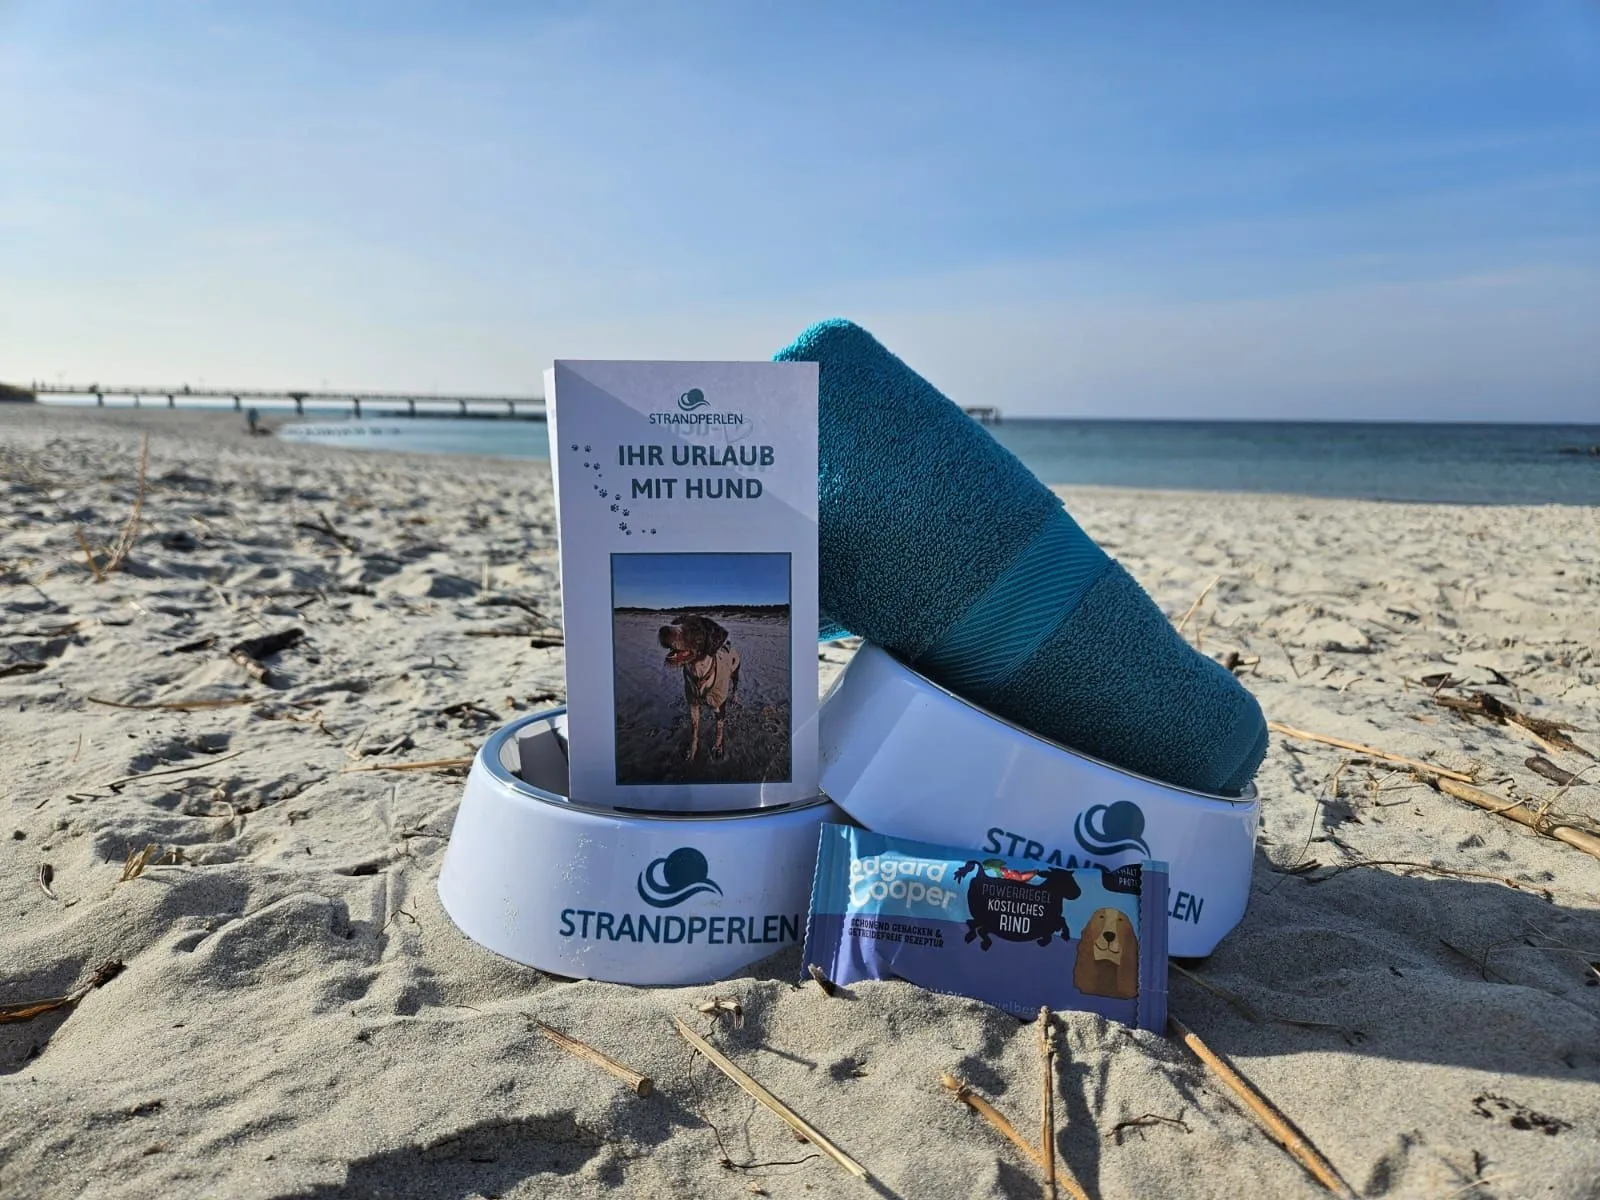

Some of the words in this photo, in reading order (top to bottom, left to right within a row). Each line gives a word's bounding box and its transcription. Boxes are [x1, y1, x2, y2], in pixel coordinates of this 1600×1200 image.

[649, 413, 743, 425] STRANDPERLEN
[618, 444, 664, 466] IHR
[672, 444, 775, 466] URLAUB
[631, 478, 677, 499] MIT
[686, 478, 763, 499] HUND
[982, 883, 1052, 904] POWERRIEGEL
[559, 908, 799, 945] STRANDPERLEN
[1000, 914, 1031, 934] RIND
